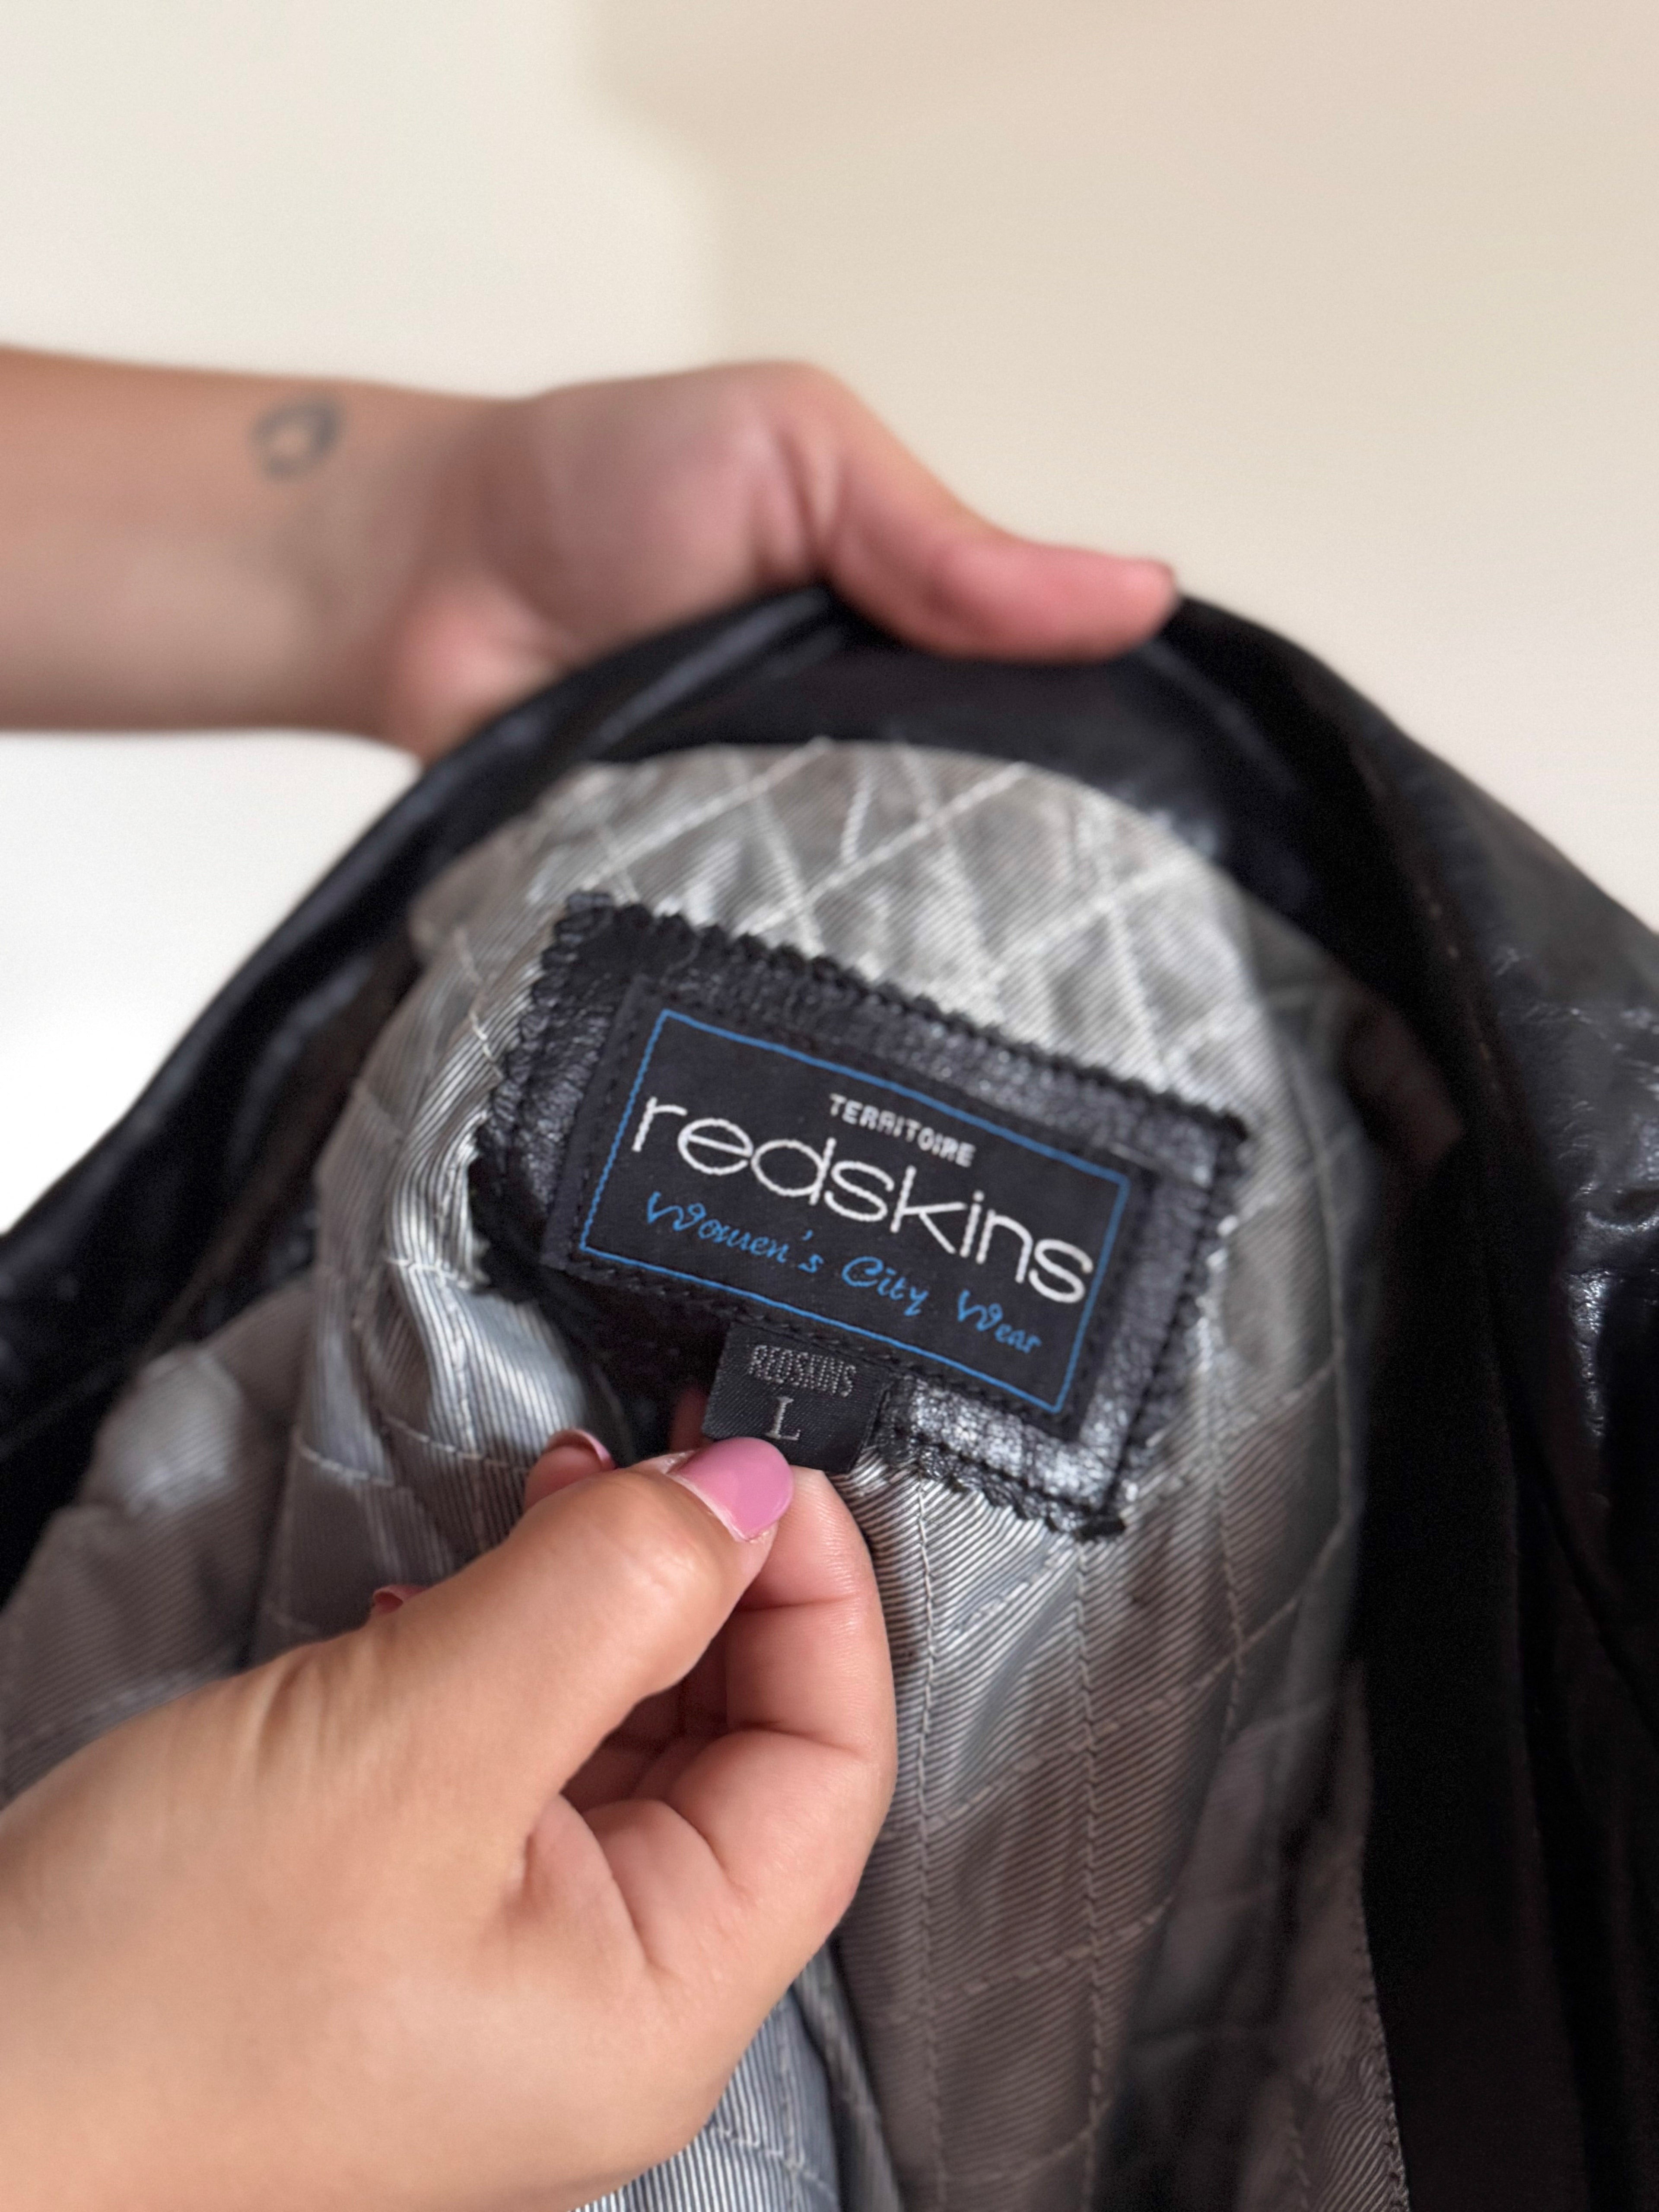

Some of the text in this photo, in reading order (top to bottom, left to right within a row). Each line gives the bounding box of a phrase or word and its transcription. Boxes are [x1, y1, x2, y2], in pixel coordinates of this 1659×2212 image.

[829, 1093, 976, 1167] TERRITOIRE
[631, 1096, 1093, 1303] redskins
[646, 1191, 1042, 1354] Women's City Wear
[748, 1344, 856, 1398] REDSKINS
[764, 1396, 801, 1441] L
